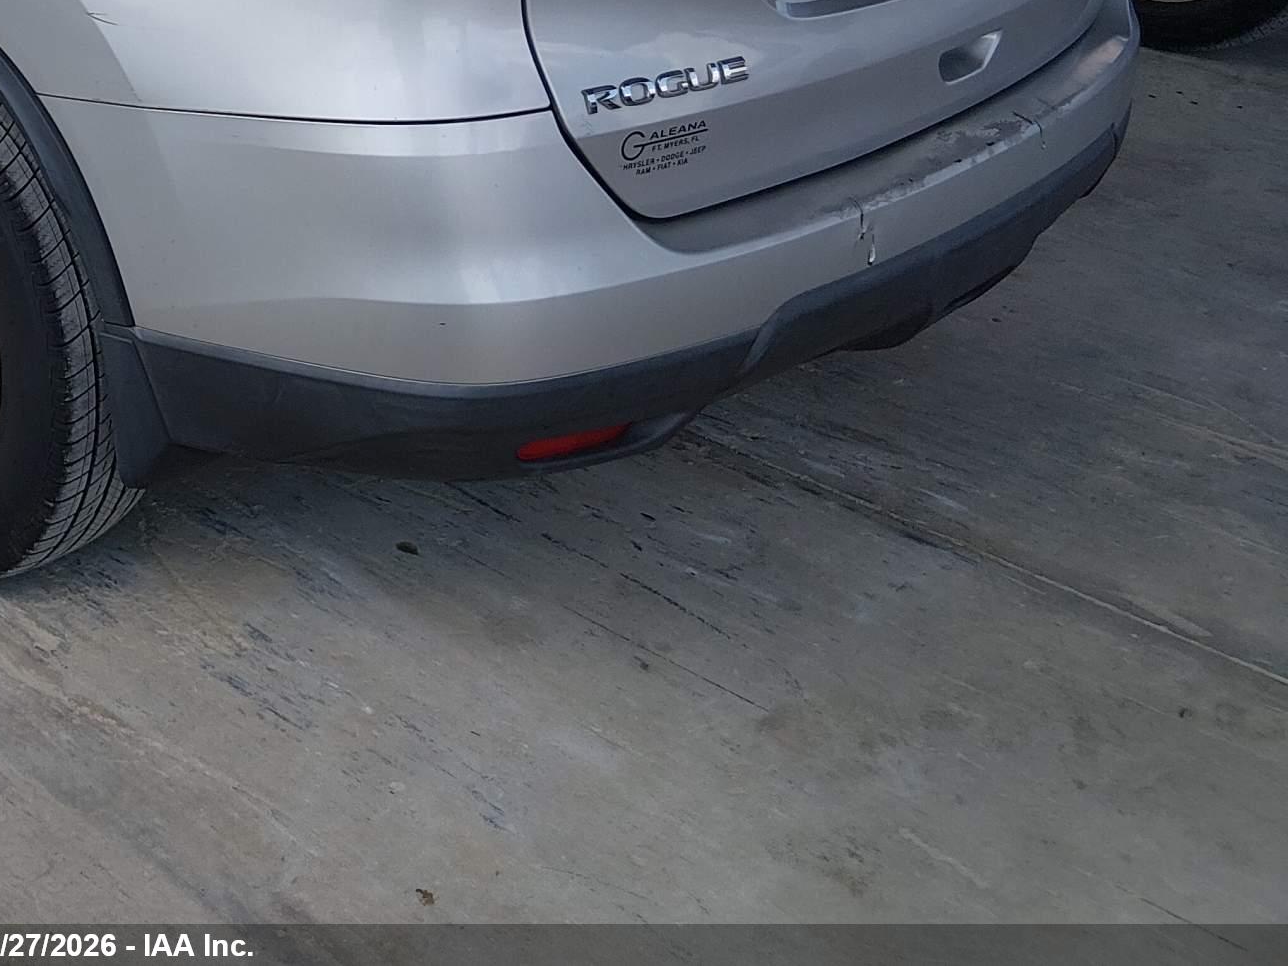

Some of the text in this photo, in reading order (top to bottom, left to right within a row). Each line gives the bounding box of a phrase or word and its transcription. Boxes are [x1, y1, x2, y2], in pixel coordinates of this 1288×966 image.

[581, 55, 750, 115] ROGUE
[621, 120, 709, 161] GALEANA
[661, 151, 685, 163] DODGE
[690, 146, 707, 155] JEEP
[636, 158, 689, 176] RAM FIAT KIA
